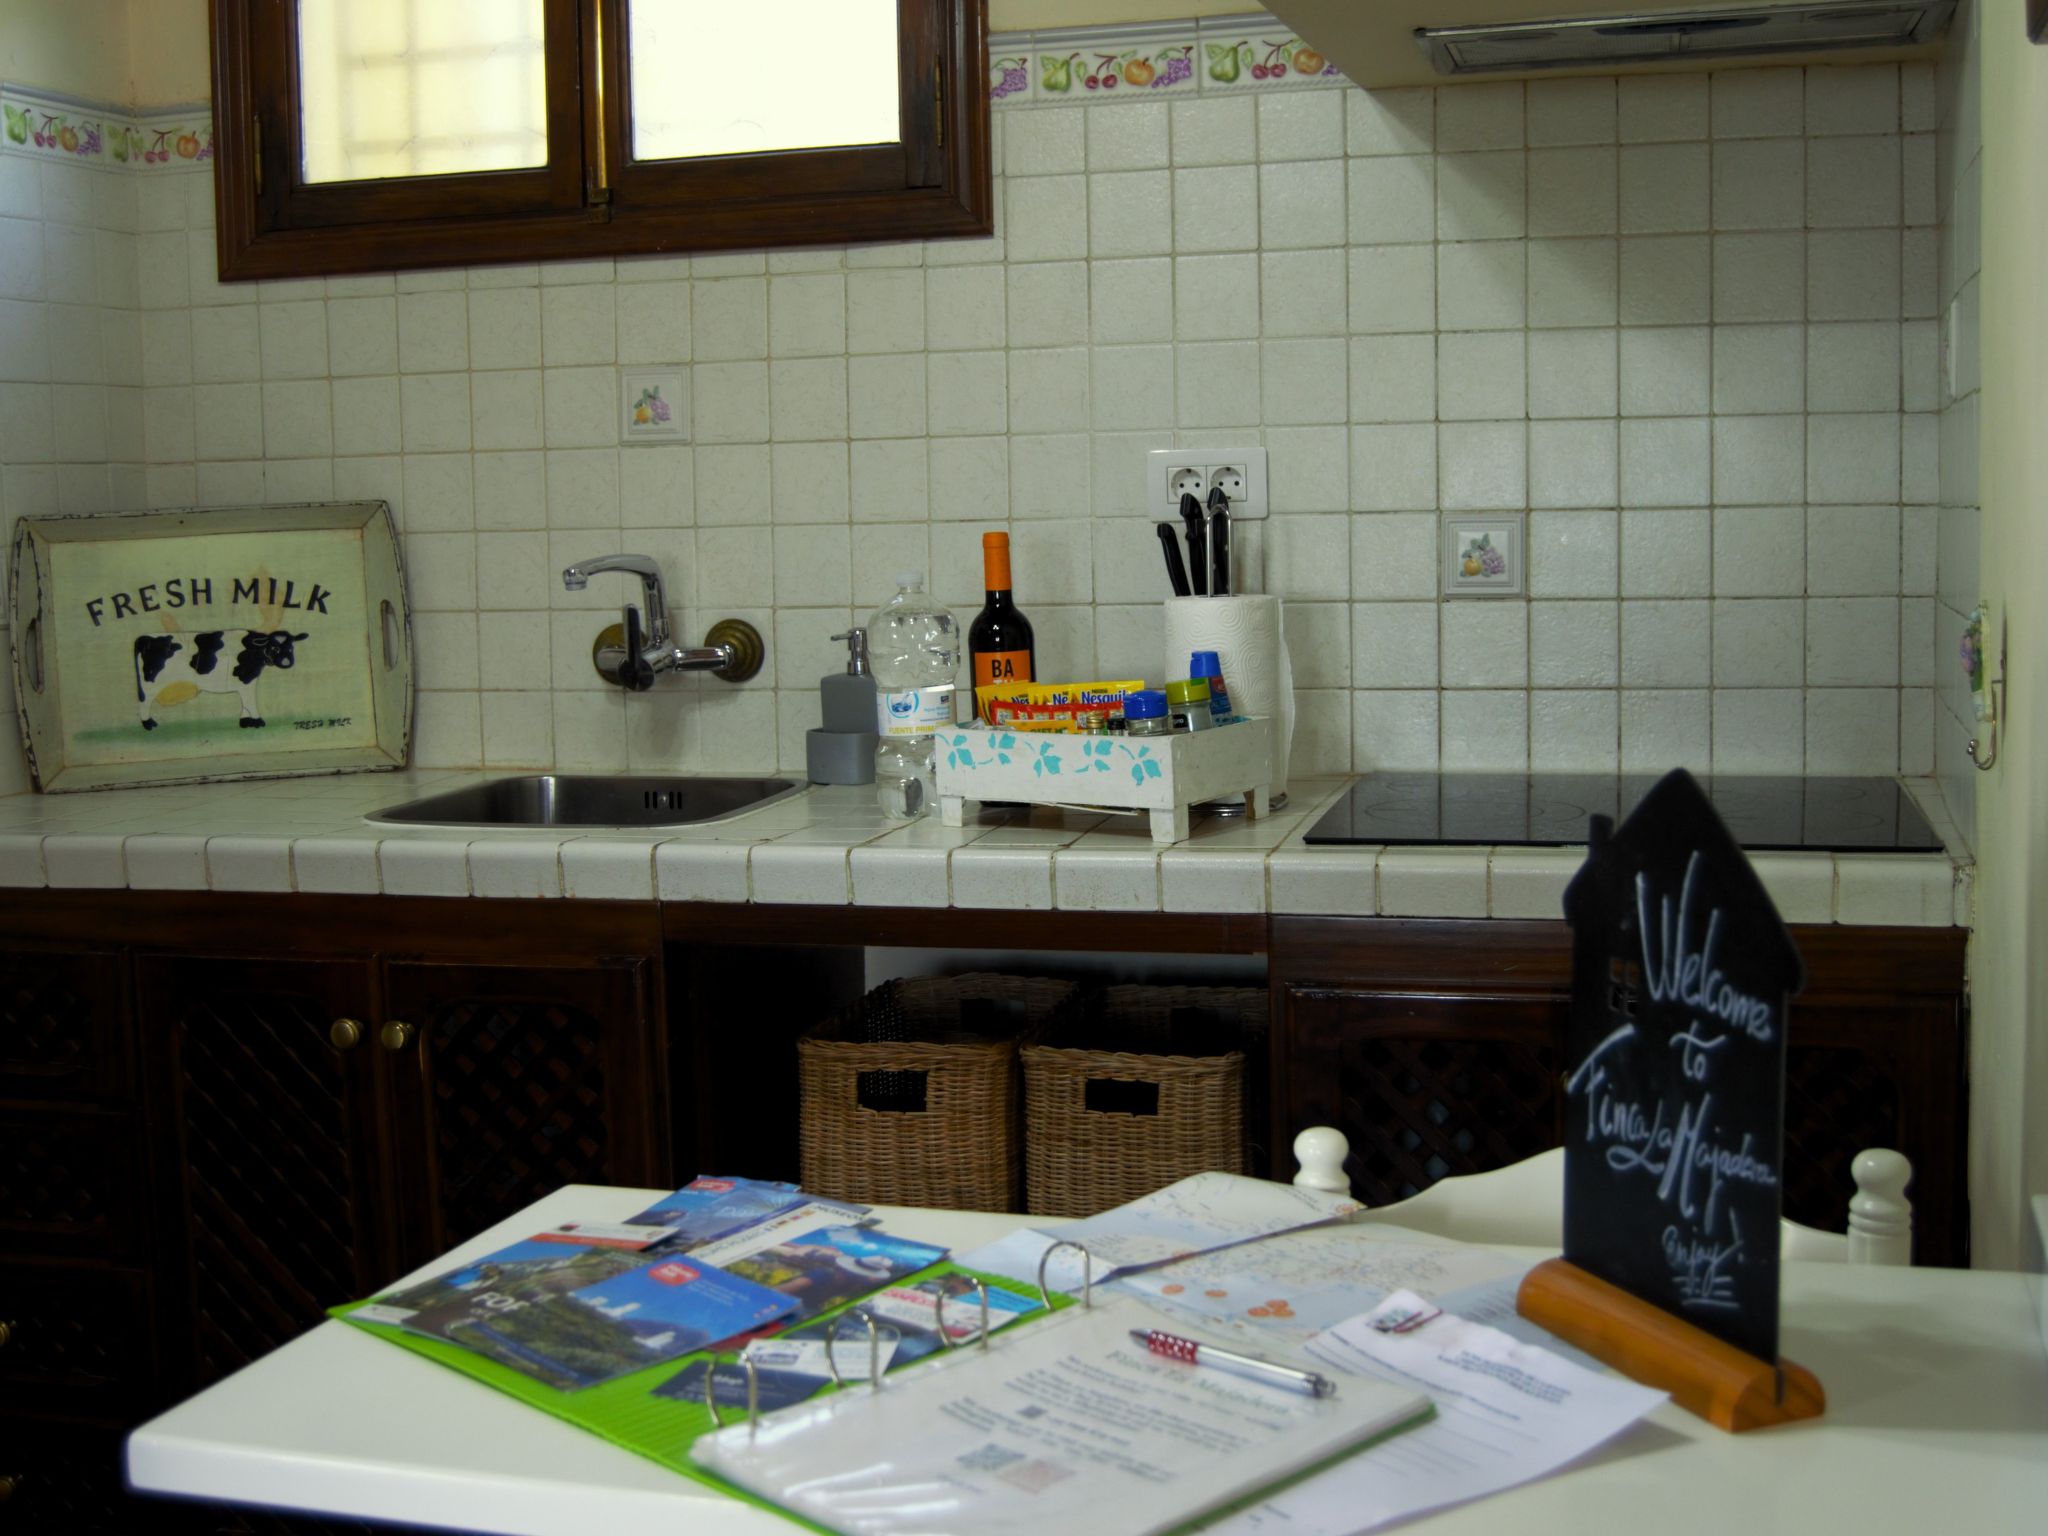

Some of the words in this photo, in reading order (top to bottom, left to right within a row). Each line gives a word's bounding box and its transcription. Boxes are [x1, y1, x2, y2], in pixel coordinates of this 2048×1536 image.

[86, 578, 213, 627] FRESH
[232, 577, 332, 615] MILK
[991, 658, 1015, 679] BA
[1635, 851, 1771, 1041] Welcome
[1567, 1023, 1651, 1142] Finca
